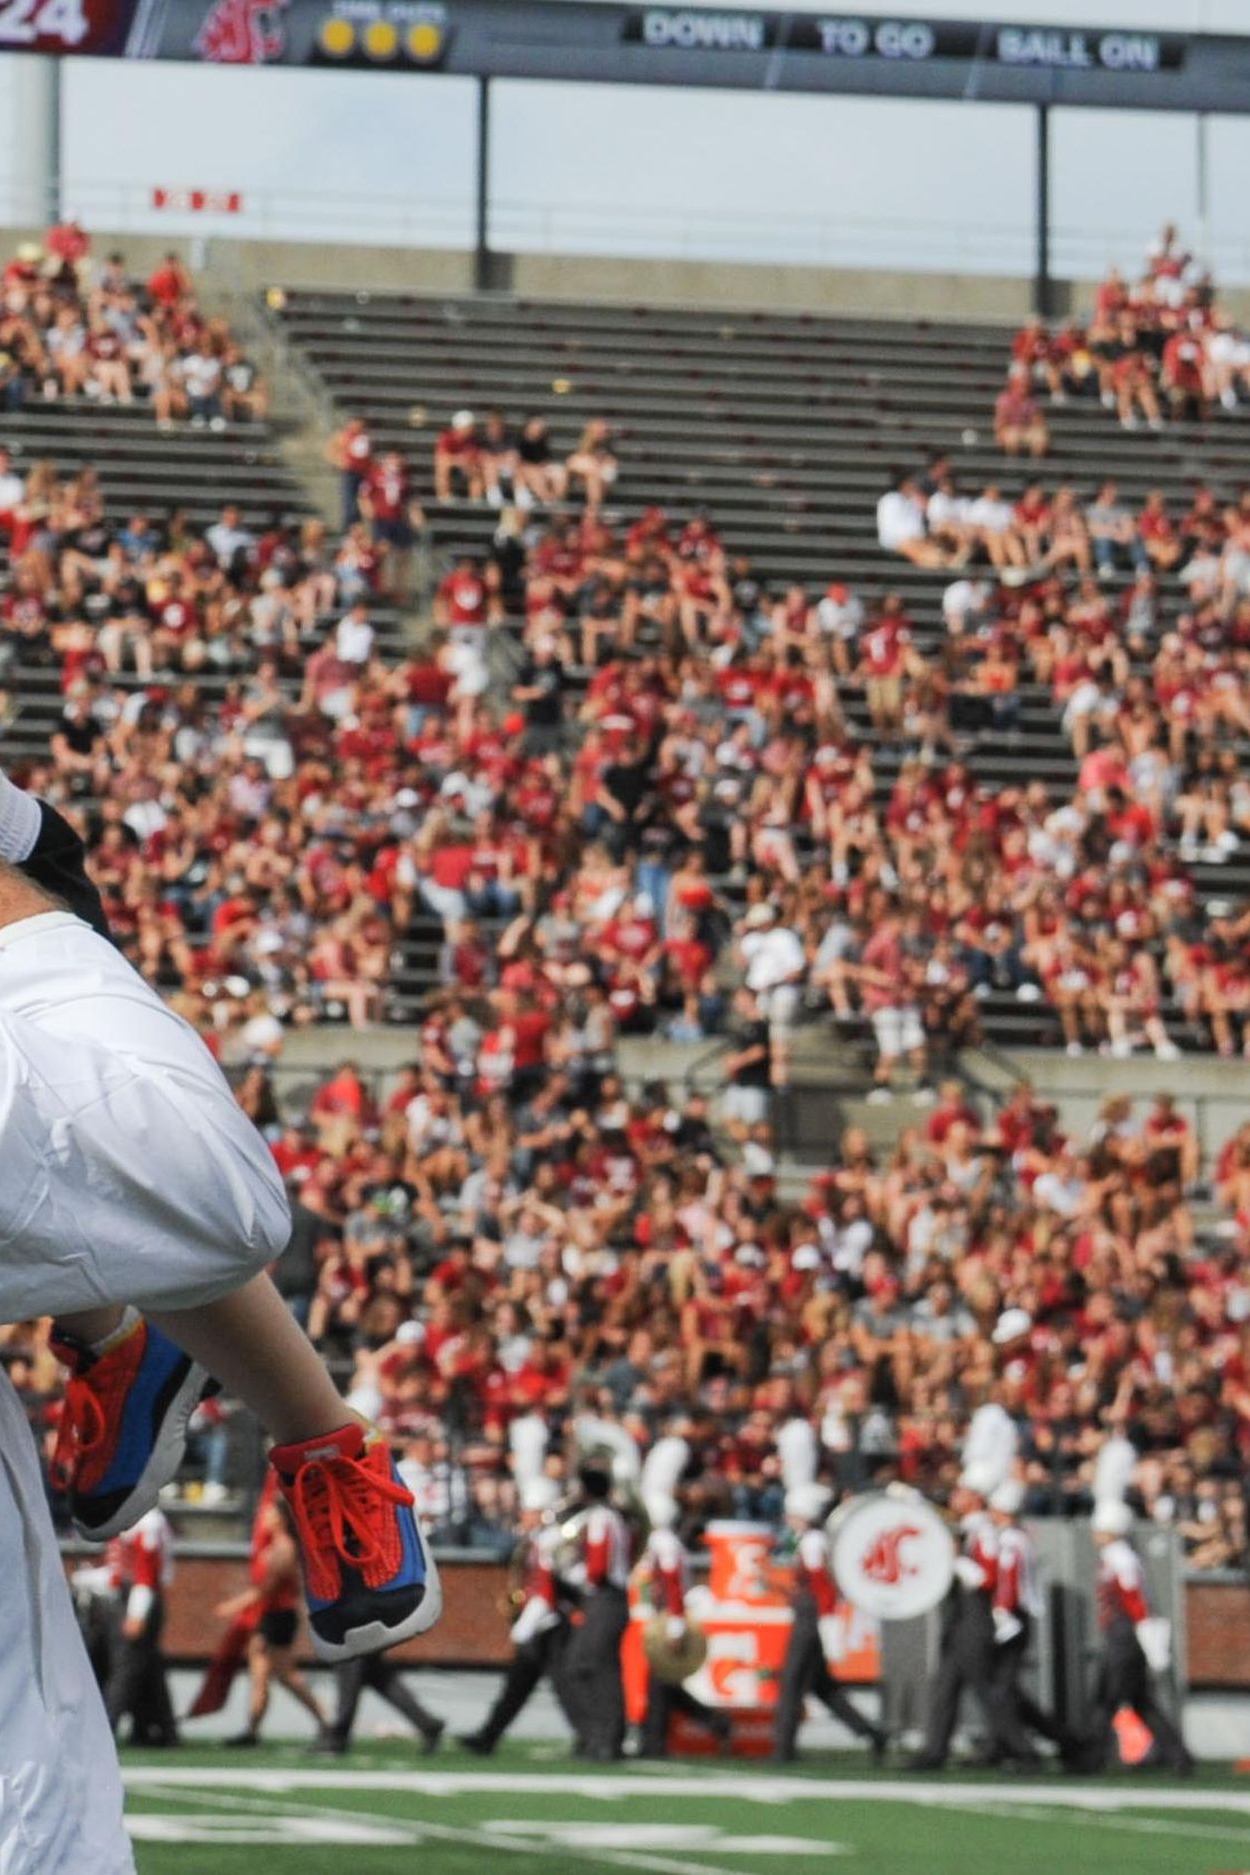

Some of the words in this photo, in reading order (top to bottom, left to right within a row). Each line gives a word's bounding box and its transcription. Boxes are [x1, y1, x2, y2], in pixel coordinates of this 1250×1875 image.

[643, 11, 764, 49] DOWN
[817, 18, 869, 56] TO
[875, 21, 934, 59] GO
[997, 28, 1092, 68] BALL
[1099, 34, 1160, 71] ON
